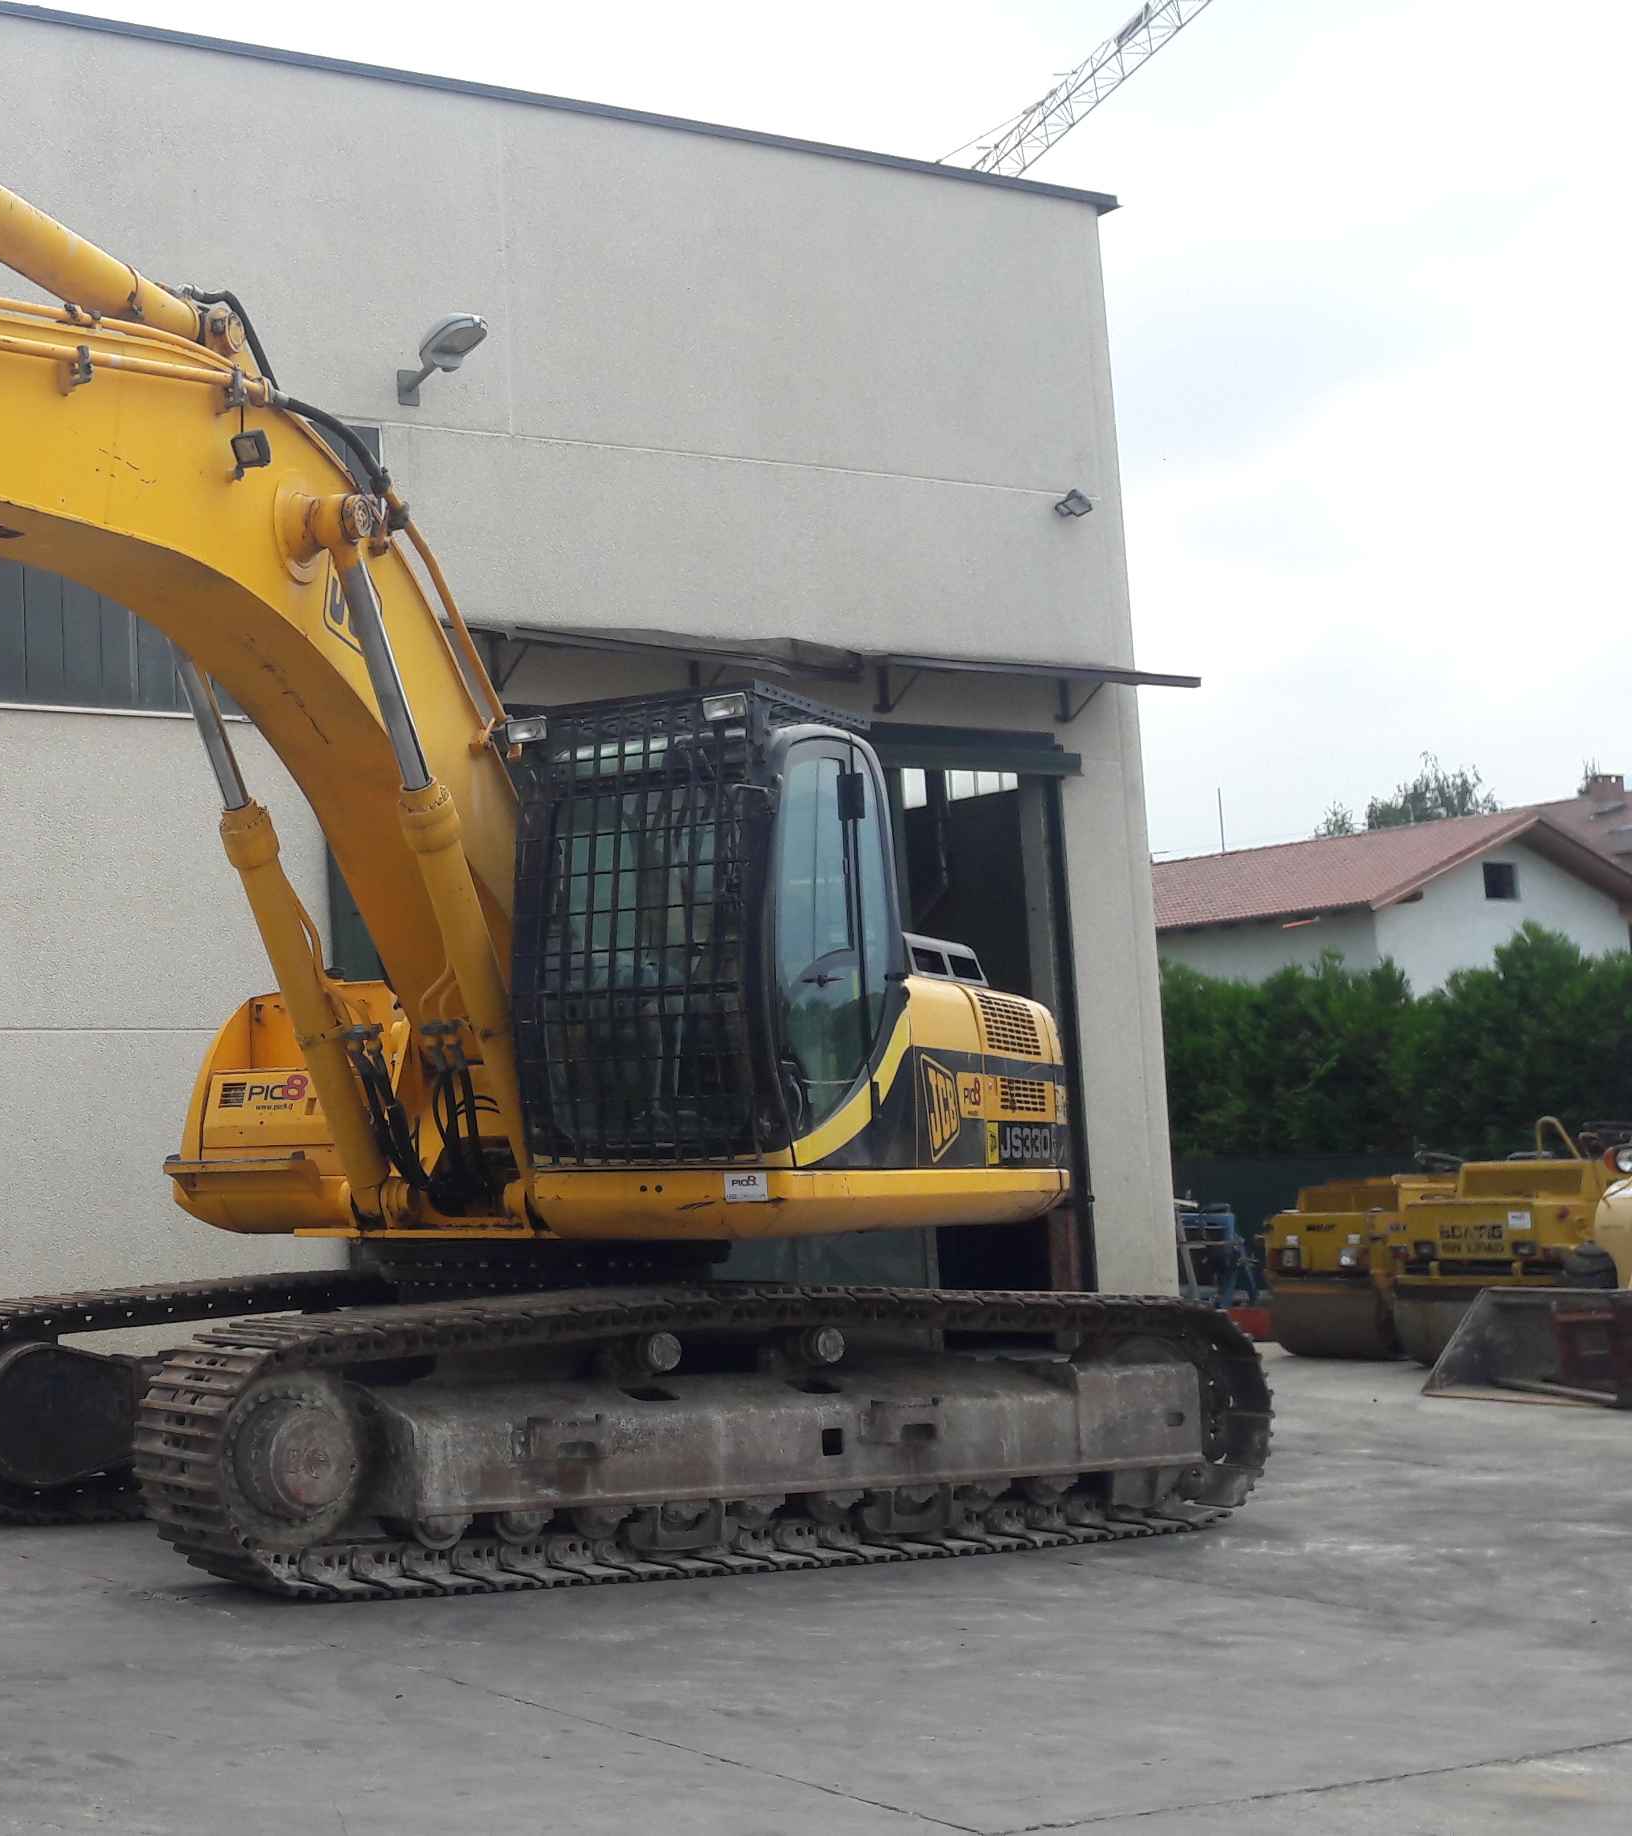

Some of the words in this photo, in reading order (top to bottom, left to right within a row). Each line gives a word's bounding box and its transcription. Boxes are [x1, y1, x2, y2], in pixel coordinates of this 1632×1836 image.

[247, 1074, 309, 1101] PIC8
[927, 1064, 959, 1149] JCB
[1000, 1126, 1051, 1160] JS330
